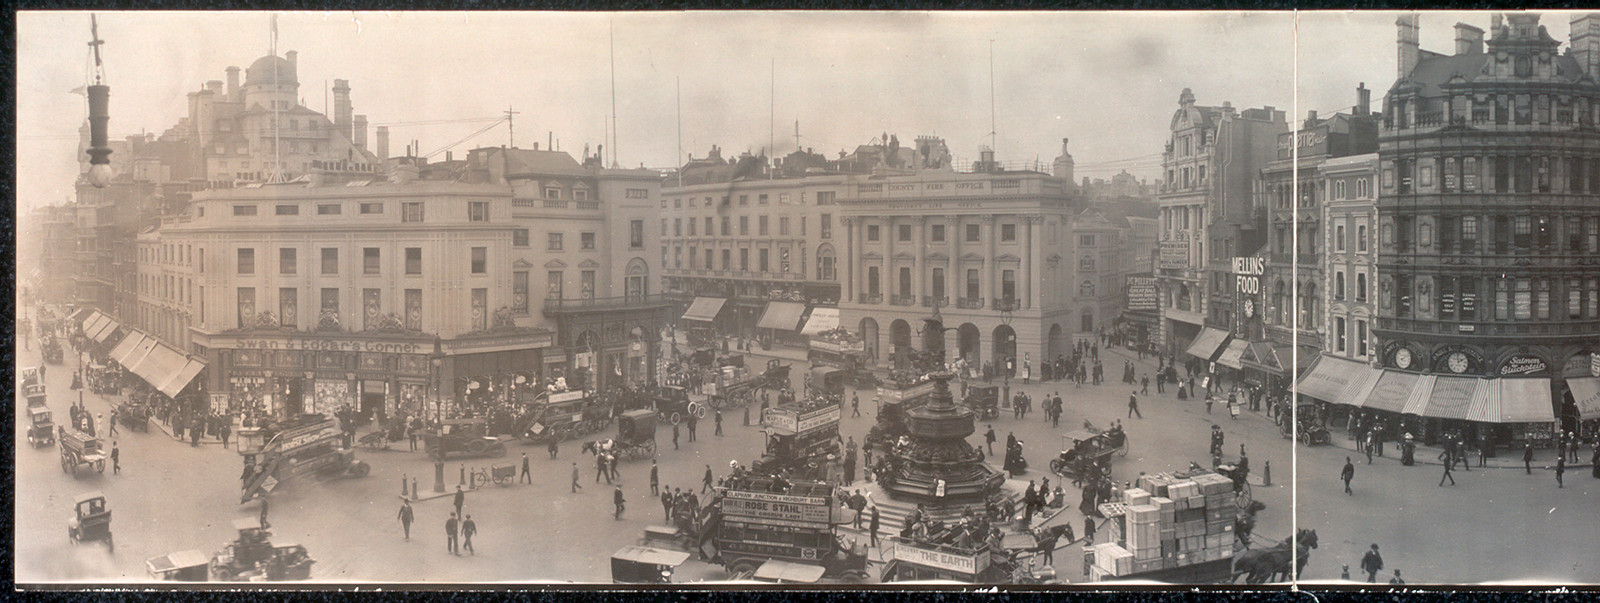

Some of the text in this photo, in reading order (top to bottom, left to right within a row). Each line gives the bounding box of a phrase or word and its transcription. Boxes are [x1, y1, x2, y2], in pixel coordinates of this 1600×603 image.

[956, 182, 984, 190] OFFICE
[1232, 254, 1264, 275] MELLIN'S
[1236, 275, 1259, 294] FOOD
[237, 339, 421, 353] Swan & Edgar's Corner
[1509, 356, 1540, 364] Salmon
[783, 495, 807, 503] HIGHBURY
[745, 501, 768, 511] ROSE
[773, 503, 801, 514] STAHL
[920, 551, 939, 563] THE
[940, 555, 974, 569] EARTH
